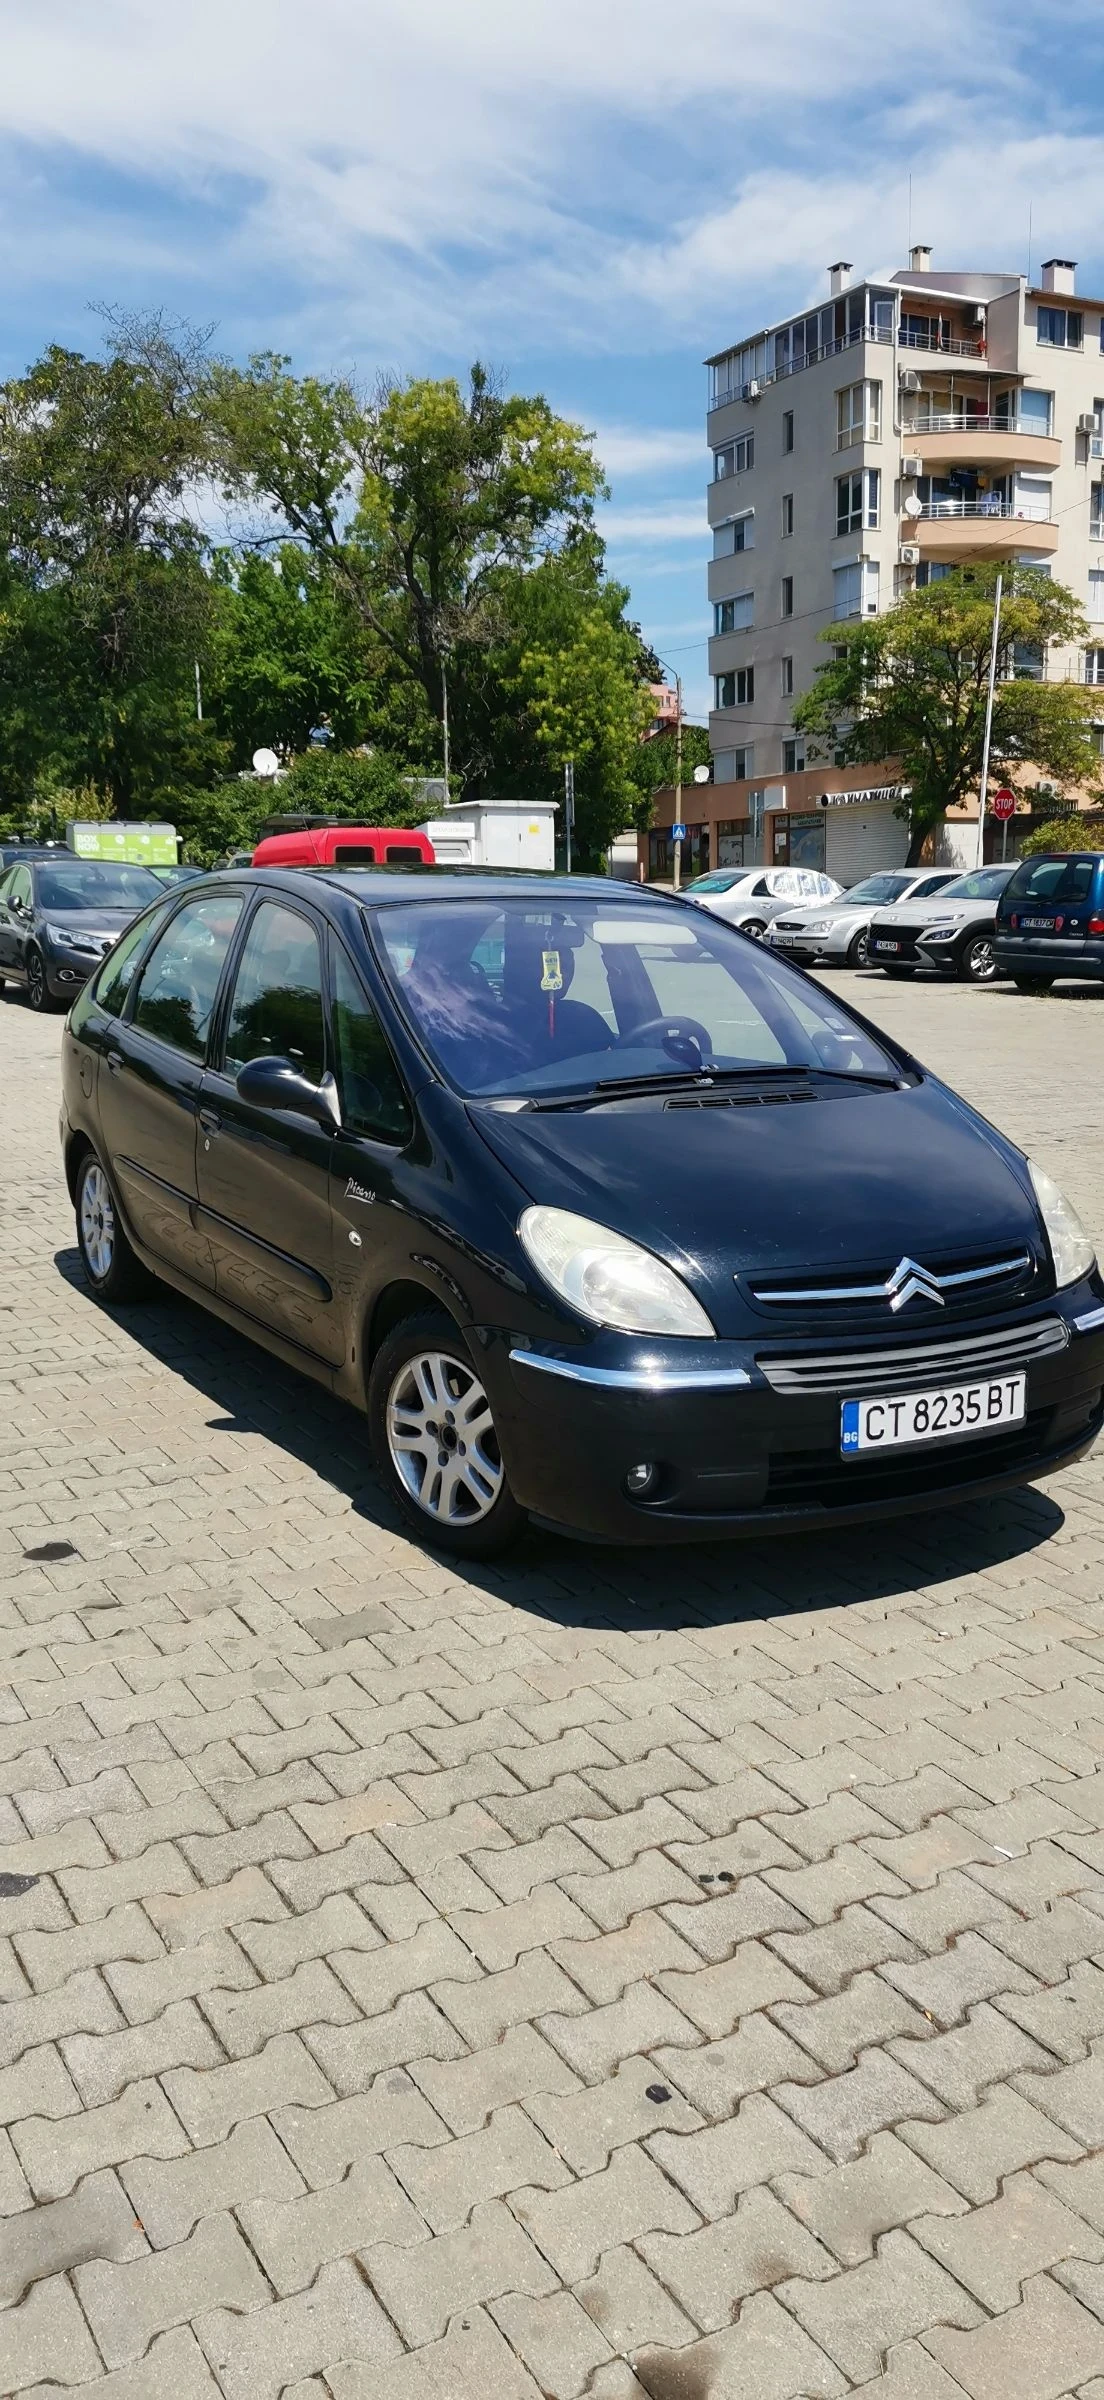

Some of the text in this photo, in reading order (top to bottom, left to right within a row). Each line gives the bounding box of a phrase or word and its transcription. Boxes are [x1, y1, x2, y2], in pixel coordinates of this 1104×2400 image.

[996, 799, 1012, 809] STOP
[866, 1381, 1020, 1440] CT 8235 BT
[843, 1432, 858, 1443] BG
